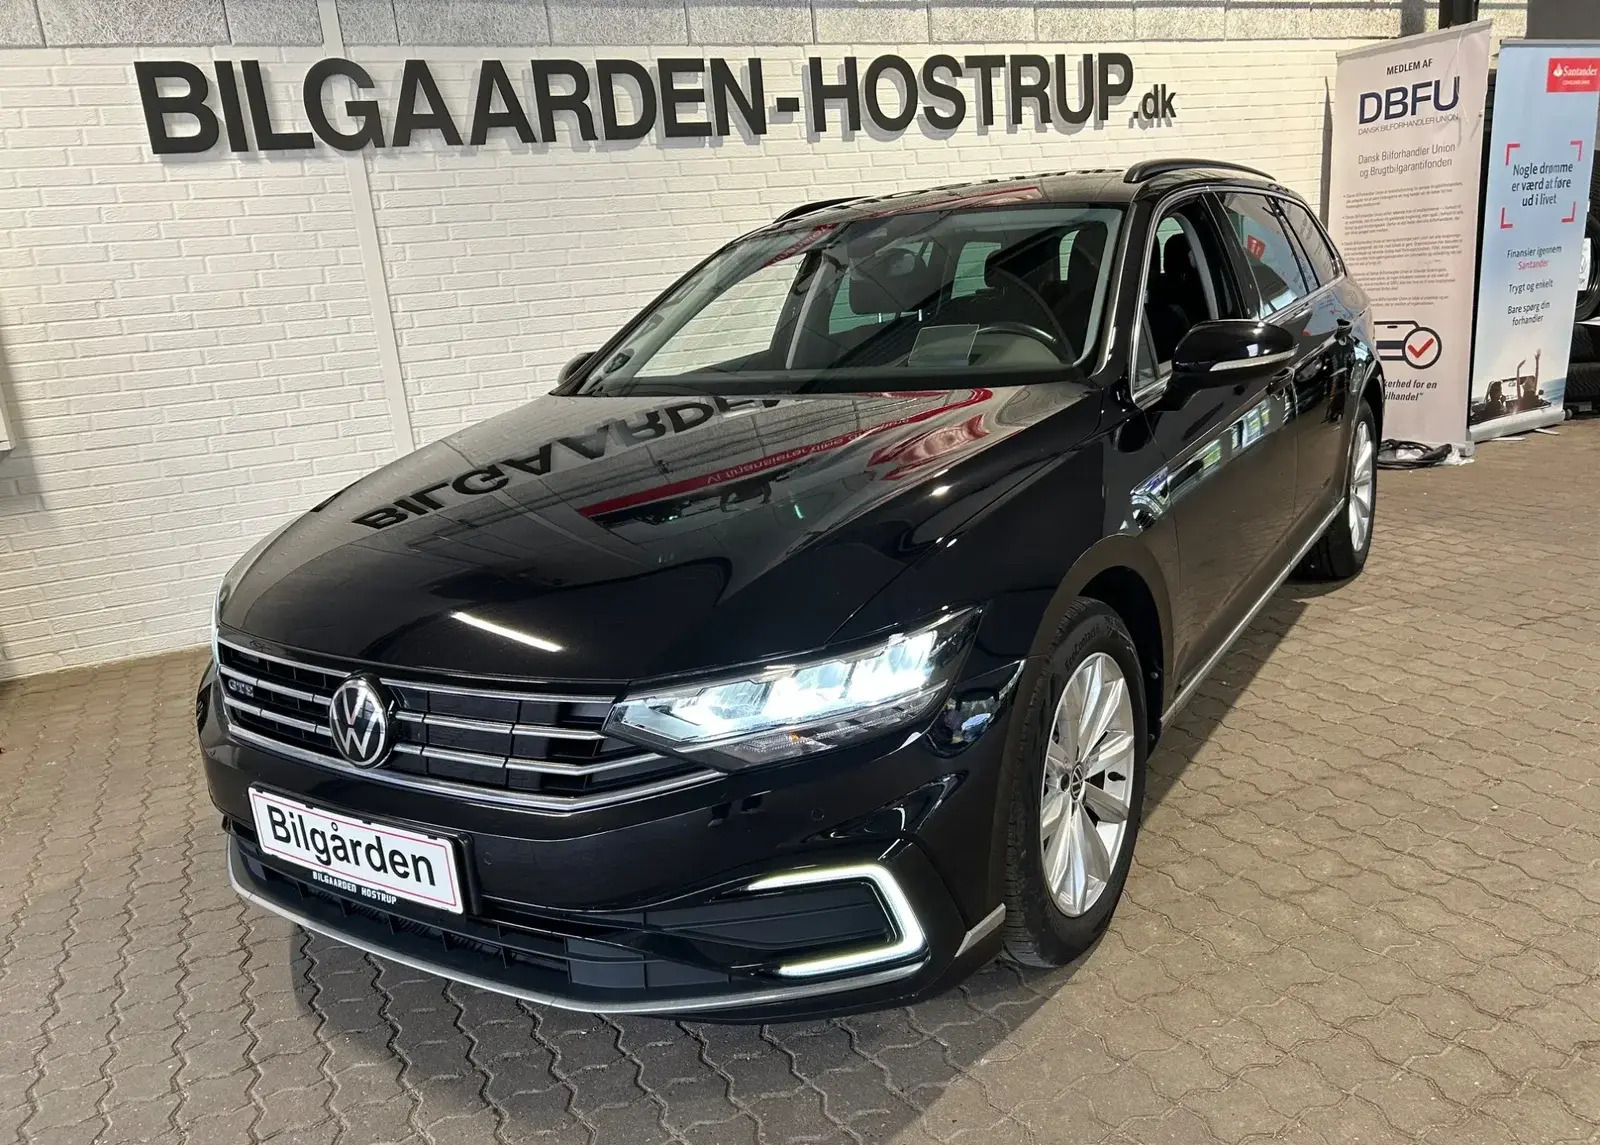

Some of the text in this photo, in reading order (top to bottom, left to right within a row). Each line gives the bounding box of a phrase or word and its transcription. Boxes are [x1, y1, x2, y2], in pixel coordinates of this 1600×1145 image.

[1386, 58, 1433, 75] MEDLEM AF
[1563, 64, 1598, 76] Santander
[1359, 76, 1460, 124] DBFU
[1358, 113, 1459, 136] DANSK BILFORHANDLER UNION
[1358, 143, 1456, 165] Dansk Bilforhandler Union
[1360, 158, 1452, 179] og Brugtbilgarantifonden
[1513, 162, 1573, 178] Nogle drømme
[1512, 177, 1571, 192] er værd at føre
[1522, 194, 1534, 206] ud
[1540, 193, 1557, 205] livet
[1507, 246, 1562, 258] Finansier igennem
[1518, 260, 1549, 270] Santander
[1509, 279, 1553, 294] Trygt og enkelt
[1508, 301, 1550, 314] Bare spørg din
[1512, 314, 1544, 326] forhandler
[1384, 379, 1411, 388] kerhed
[1413, 379, 1425, 388] for
[266, 804, 436, 887] Bilgården
[312, 870, 397, 905] BILGAARDEN HOSTRUP
